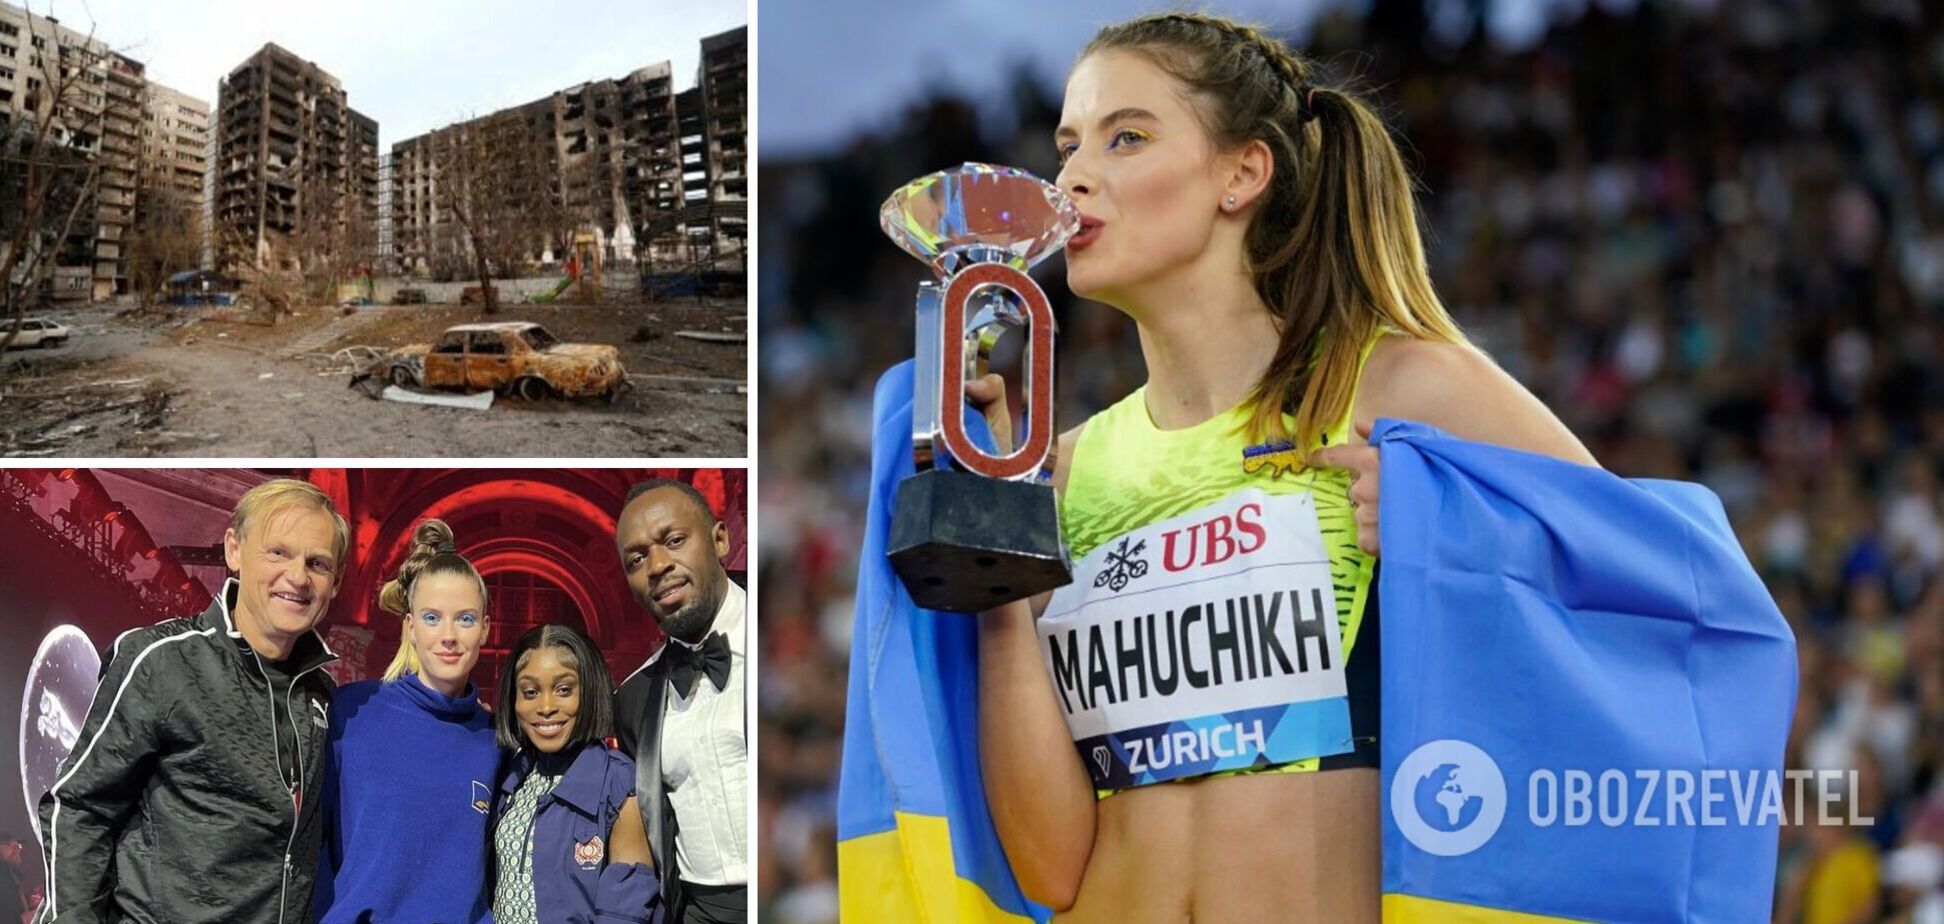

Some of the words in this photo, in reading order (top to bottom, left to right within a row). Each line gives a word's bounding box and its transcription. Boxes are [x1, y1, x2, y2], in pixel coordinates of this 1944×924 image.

[1161, 503, 1266, 572] UBS
[1049, 588, 1330, 714] MAHUCHIKH
[1123, 720, 1266, 773] ZURICH
